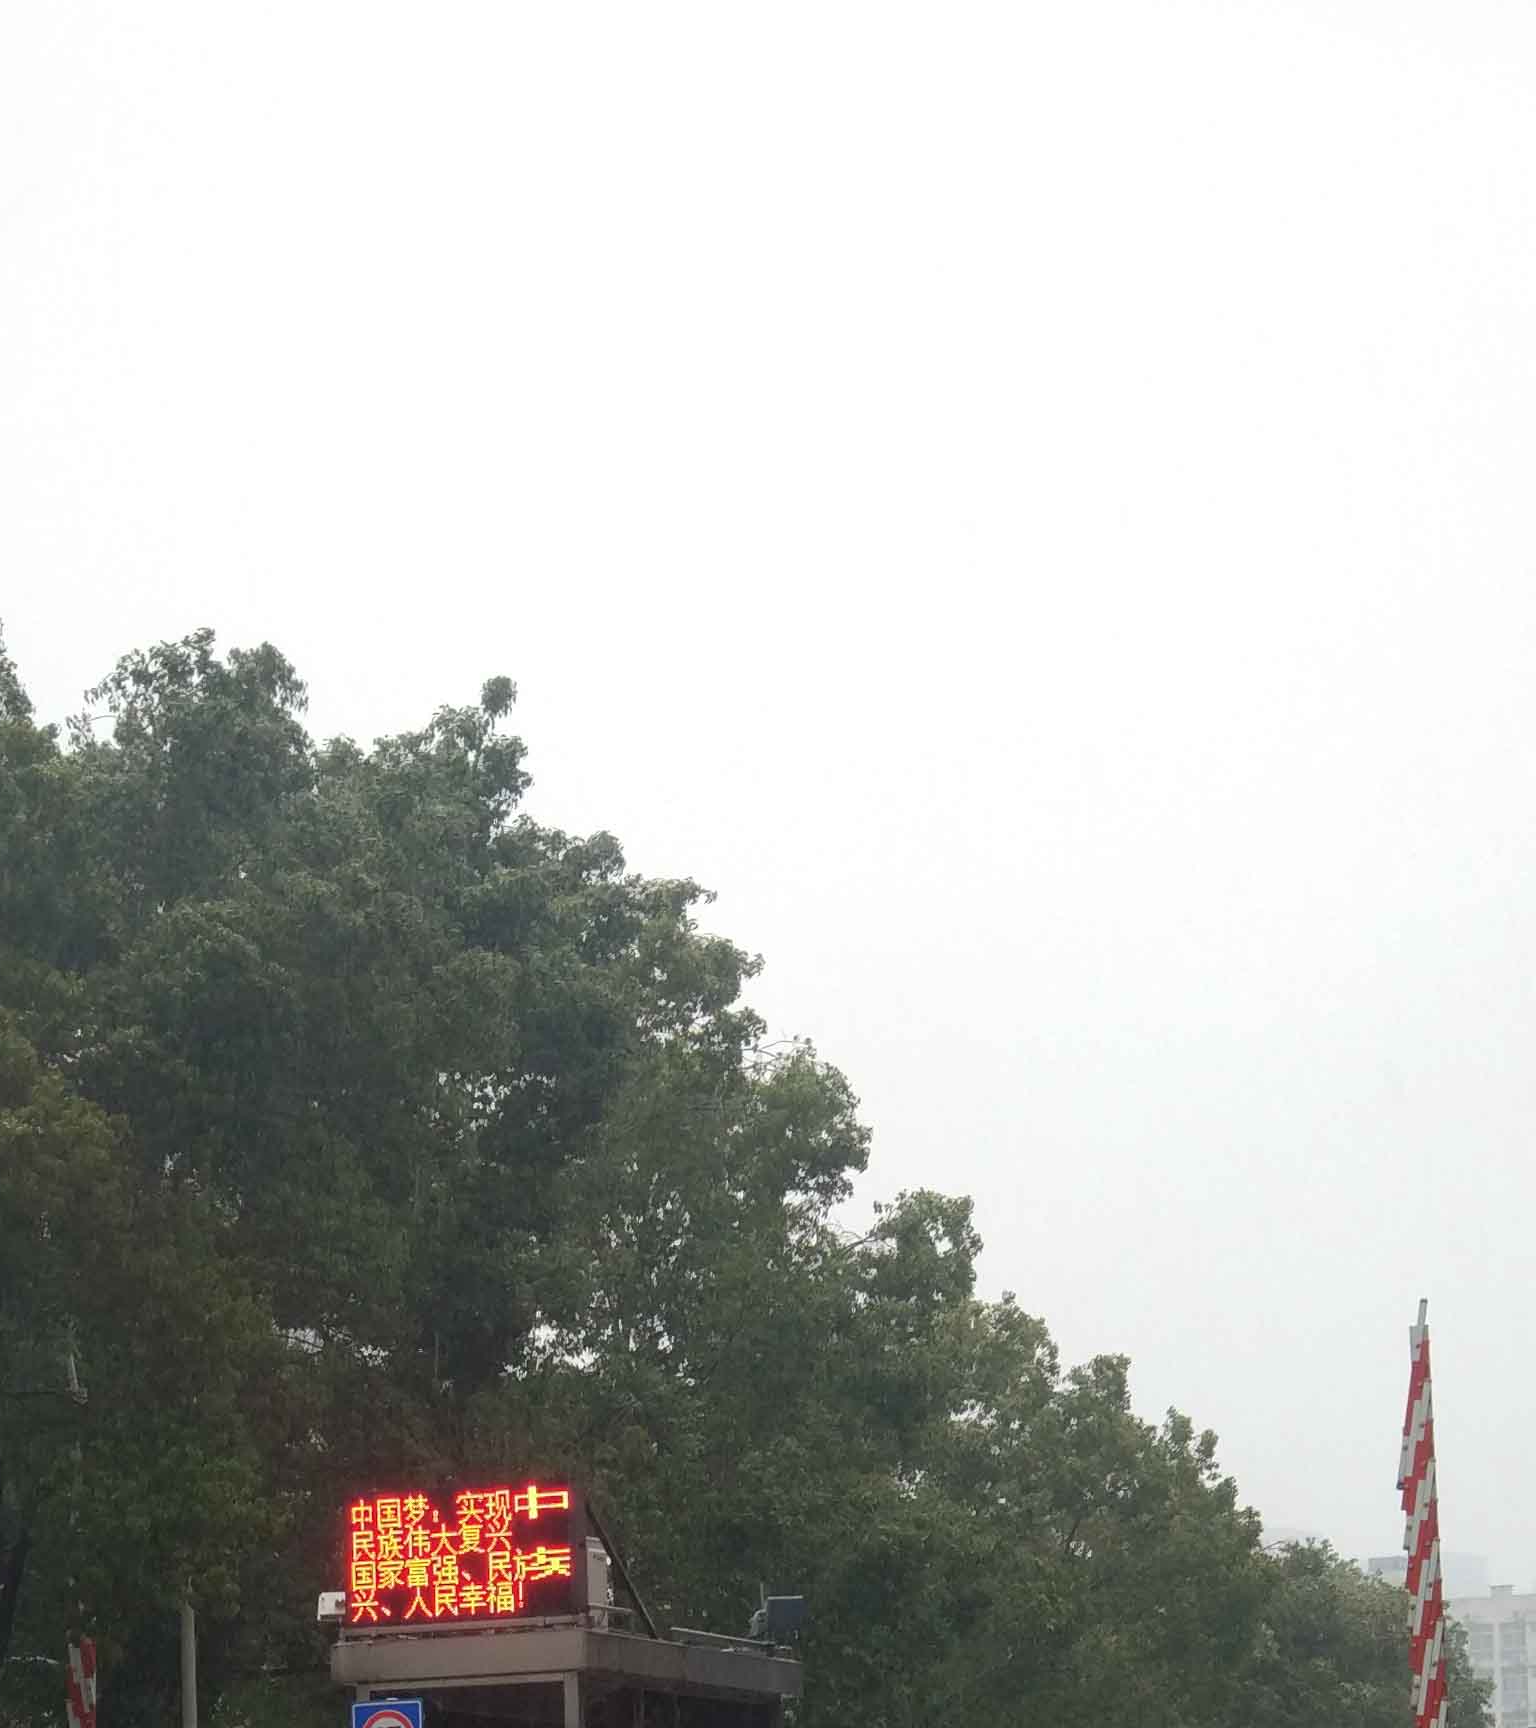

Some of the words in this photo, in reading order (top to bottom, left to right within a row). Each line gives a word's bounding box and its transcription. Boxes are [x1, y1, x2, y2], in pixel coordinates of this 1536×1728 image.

[353, 1517, 512, 1560] 民族伟大复兴
